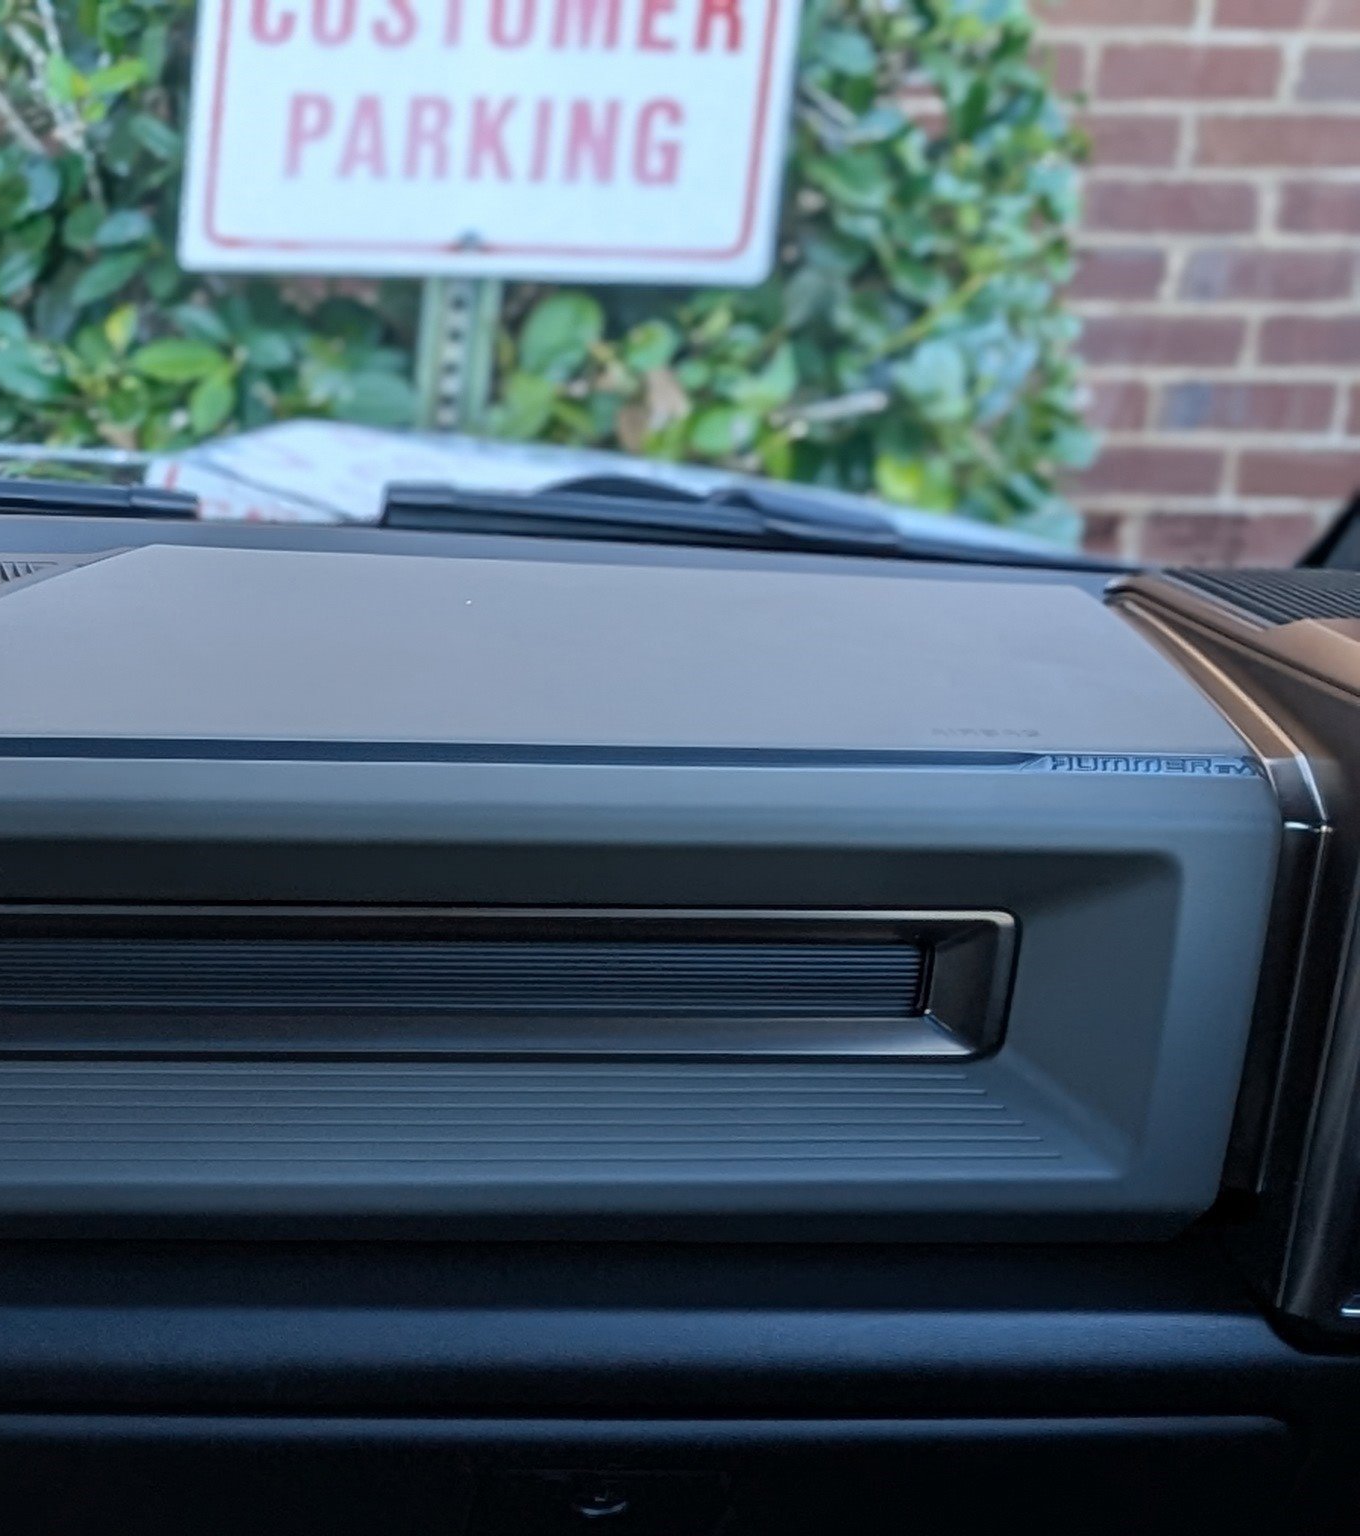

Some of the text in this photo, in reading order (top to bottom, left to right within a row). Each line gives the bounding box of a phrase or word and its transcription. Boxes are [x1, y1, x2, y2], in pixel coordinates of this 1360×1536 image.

[247, 0, 742, 53] CUSTOMER
[283, 92, 685, 187] PARKING
[1052, 755, 1212, 775] HUMMER
